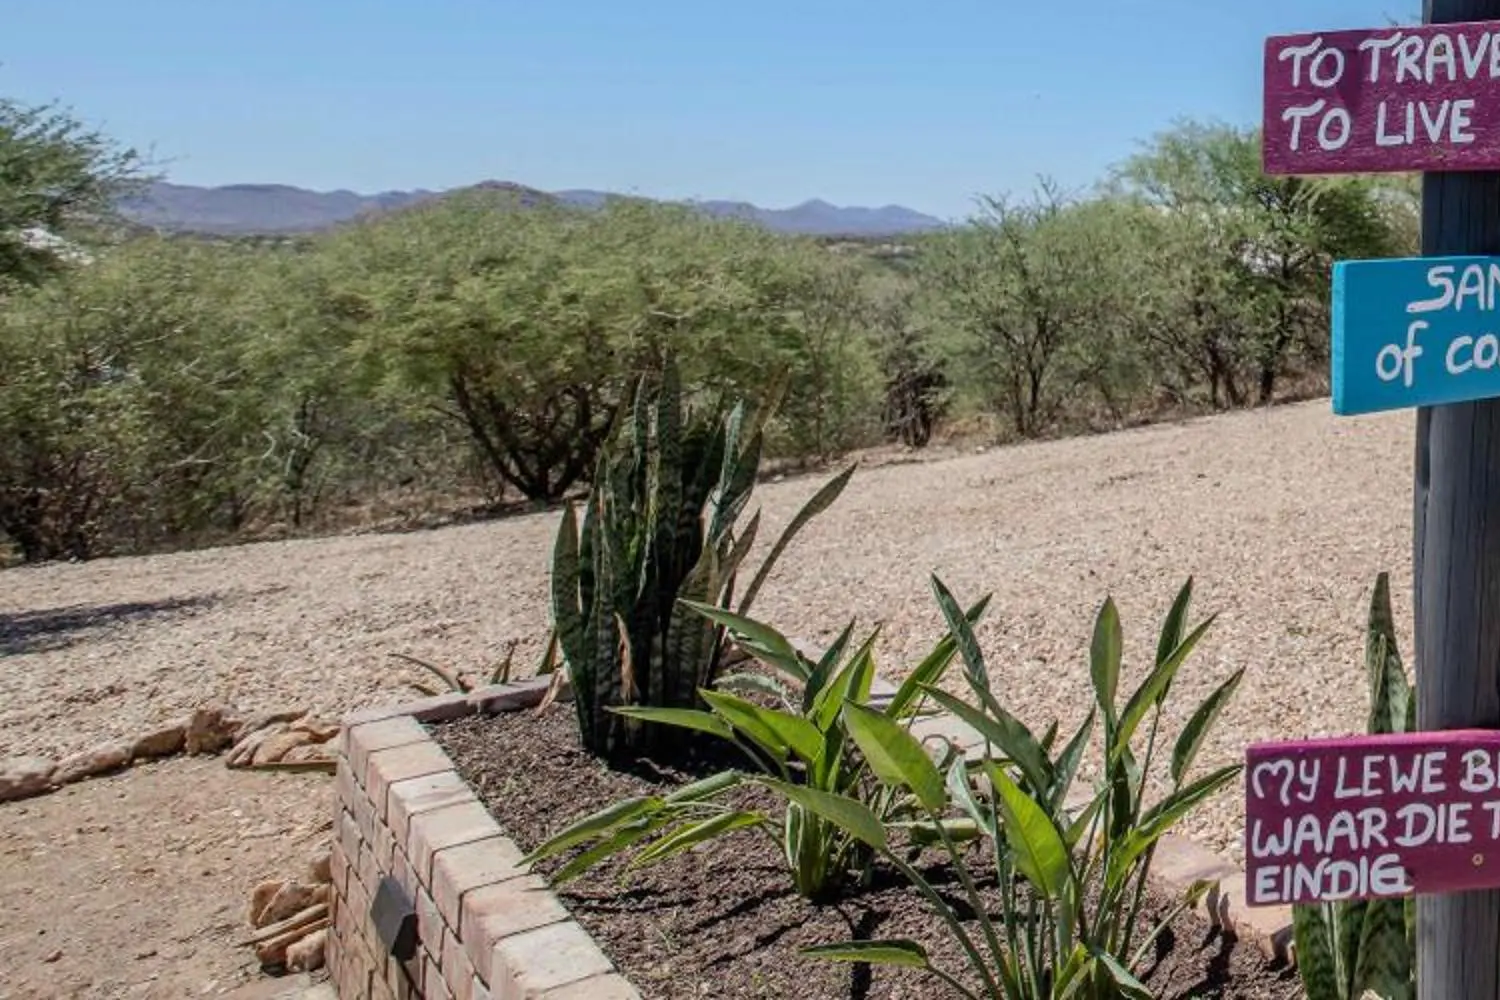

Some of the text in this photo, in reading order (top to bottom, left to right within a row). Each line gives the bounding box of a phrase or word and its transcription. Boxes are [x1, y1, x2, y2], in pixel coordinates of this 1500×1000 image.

[1279, 37, 1346, 89] TO
[1282, 99, 1475, 151] TO LIVE
[1376, 320, 1429, 387] of
[1251, 757, 1319, 806] MY
[1335, 751, 1447, 800] LEWE
[1251, 811, 1388, 858] WAAR
[1394, 803, 1473, 847] DIE
[1254, 854, 1414, 902] EINDIG
